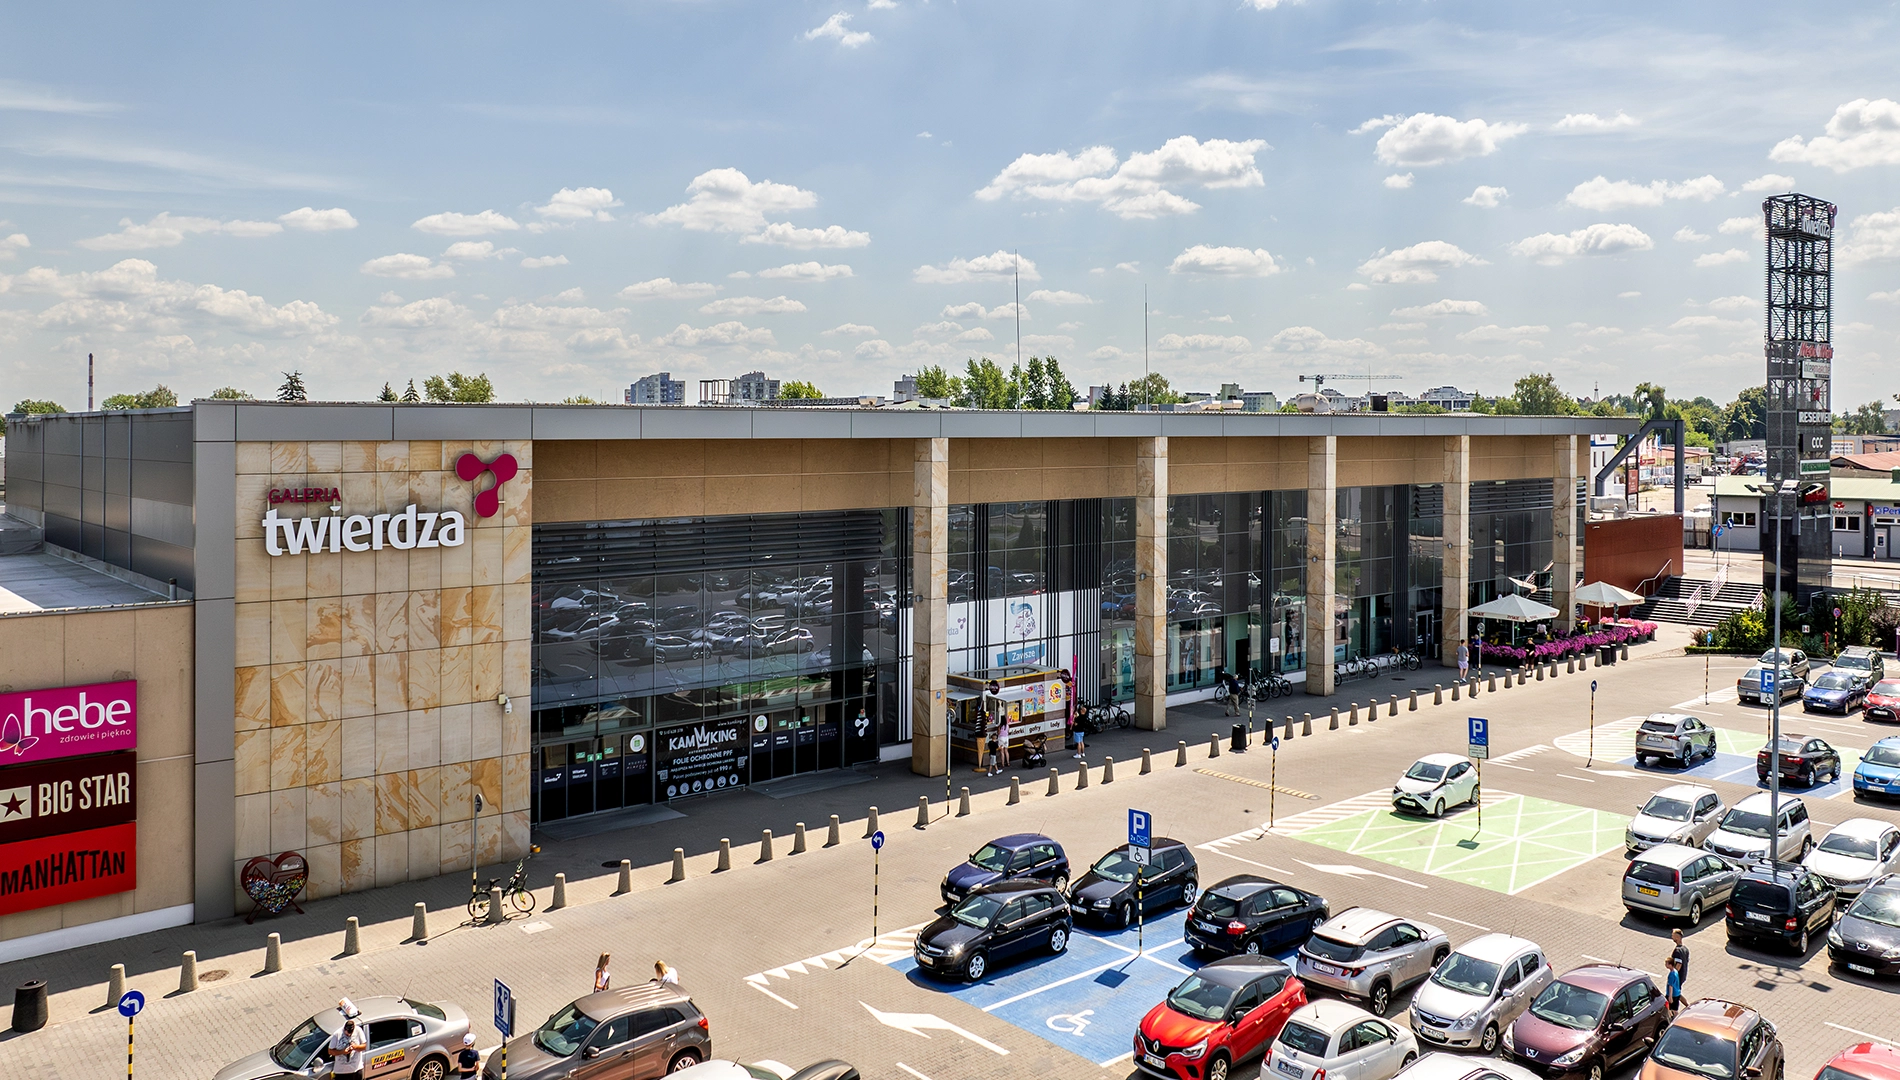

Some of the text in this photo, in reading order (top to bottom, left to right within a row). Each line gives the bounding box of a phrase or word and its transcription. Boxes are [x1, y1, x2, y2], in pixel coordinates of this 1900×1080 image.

[1811, 436, 1823, 448] CCC
[268, 487, 341, 504] GALERIA
[262, 503, 465, 557] twierdza
[1765, 672, 1774, 686] P
[24, 692, 131, 737] hebe
[60, 732, 97, 744] zdrowie
[101, 728, 132, 740] piękno
[1472, 719, 1483, 737] P
[673, 749, 733, 765] FOLIE OCHRONNE PPF
[39, 772, 130, 817] BIG STAR
[1133, 812, 1145, 834] P
[0, 850, 126, 896] MANHATTAN
